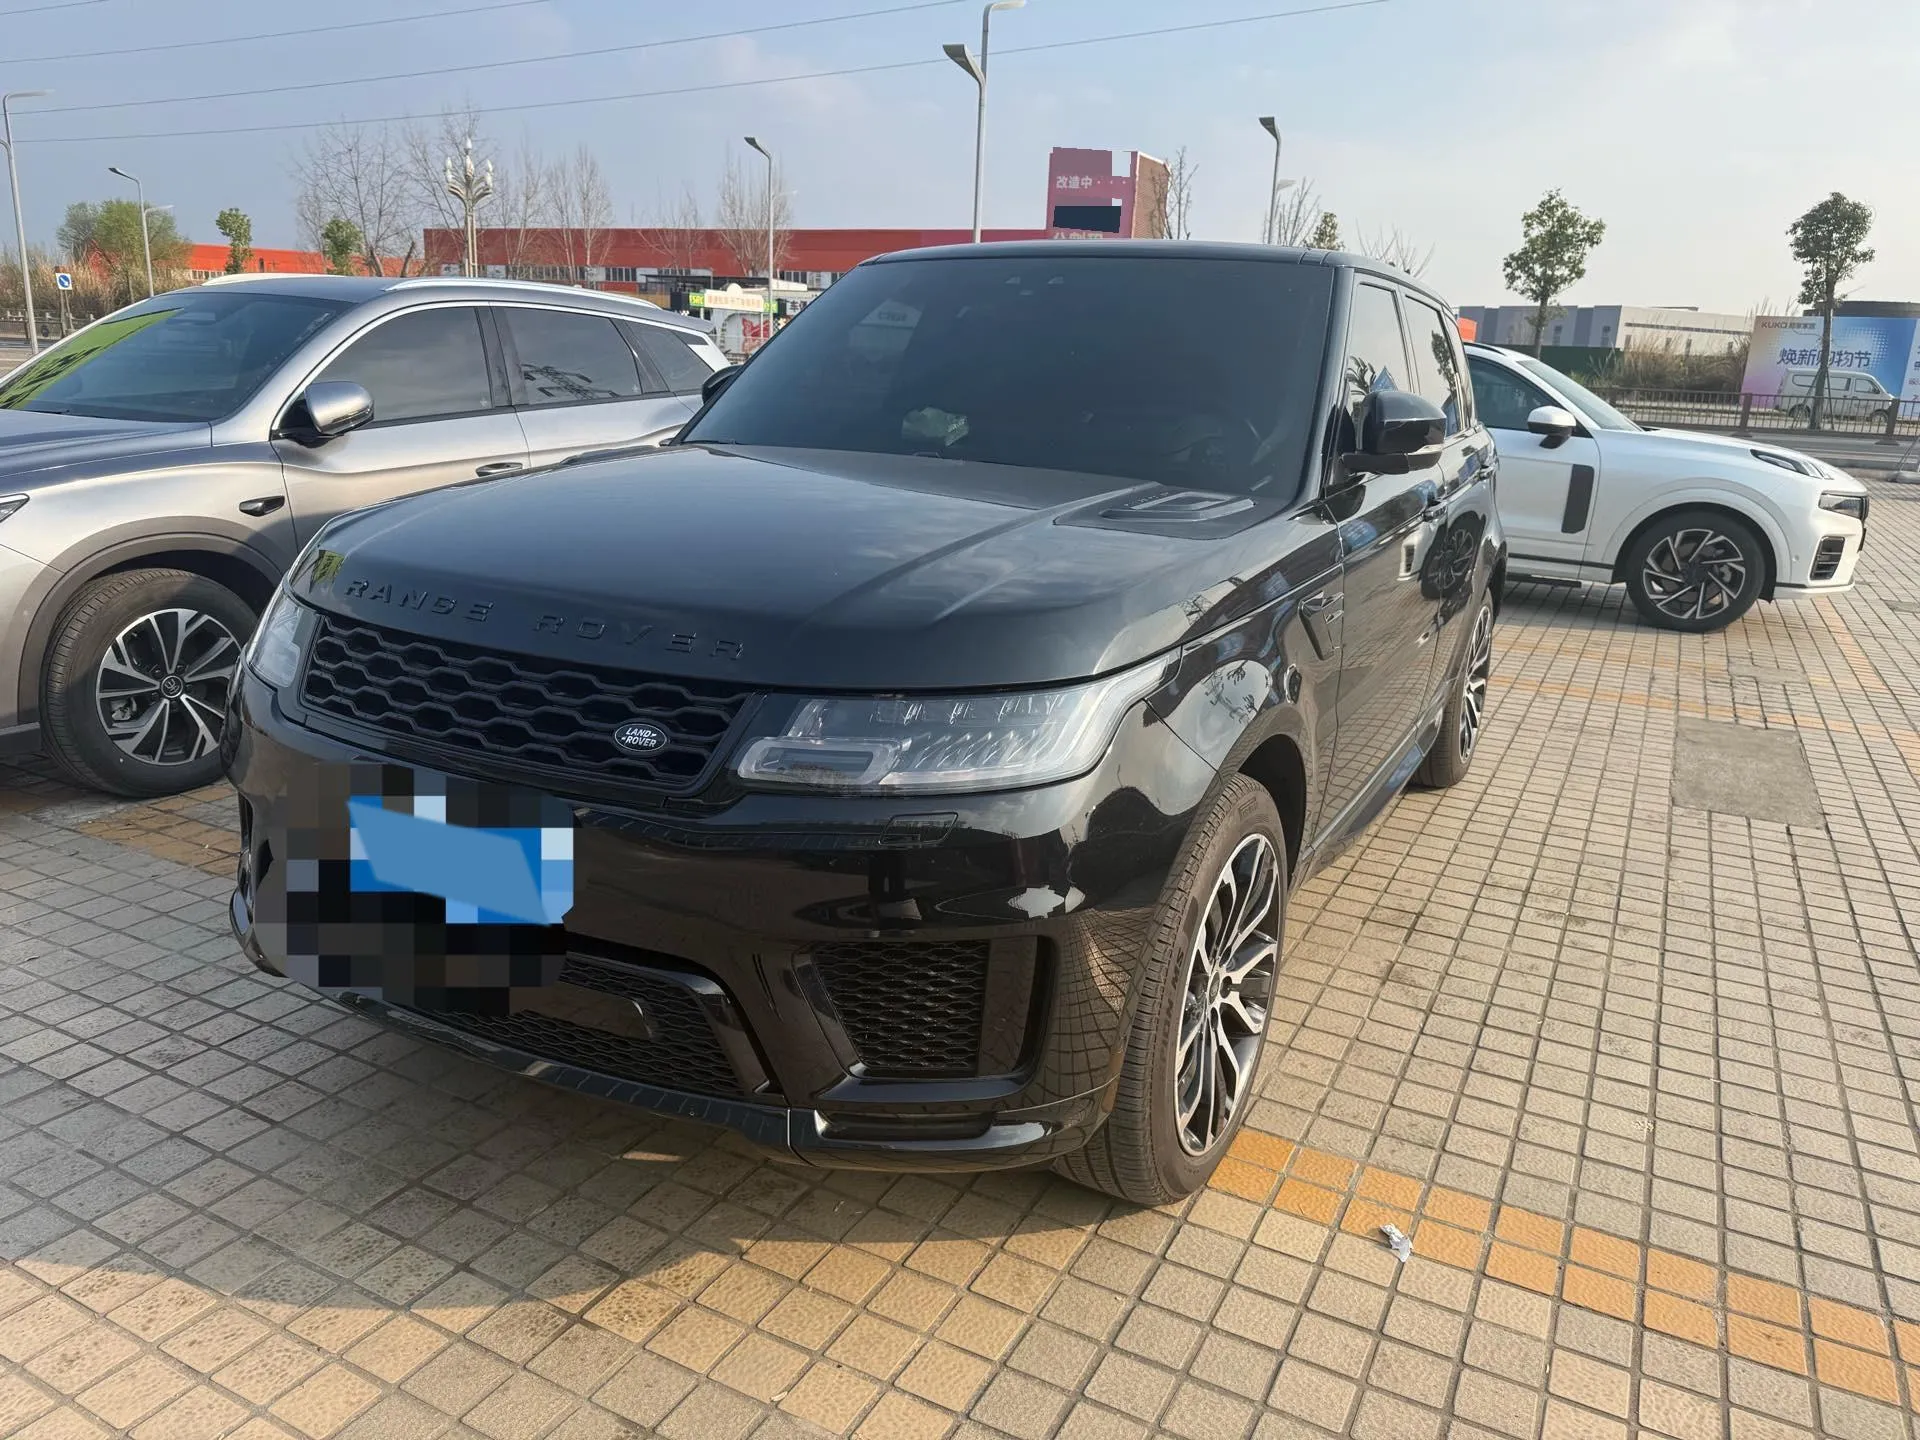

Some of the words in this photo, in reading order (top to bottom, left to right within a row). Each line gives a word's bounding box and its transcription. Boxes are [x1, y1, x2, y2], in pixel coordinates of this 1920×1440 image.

[533, 614, 745, 661] ROVER
[625, 727, 652, 738] LAND
[624, 735, 657, 748] ROVER
